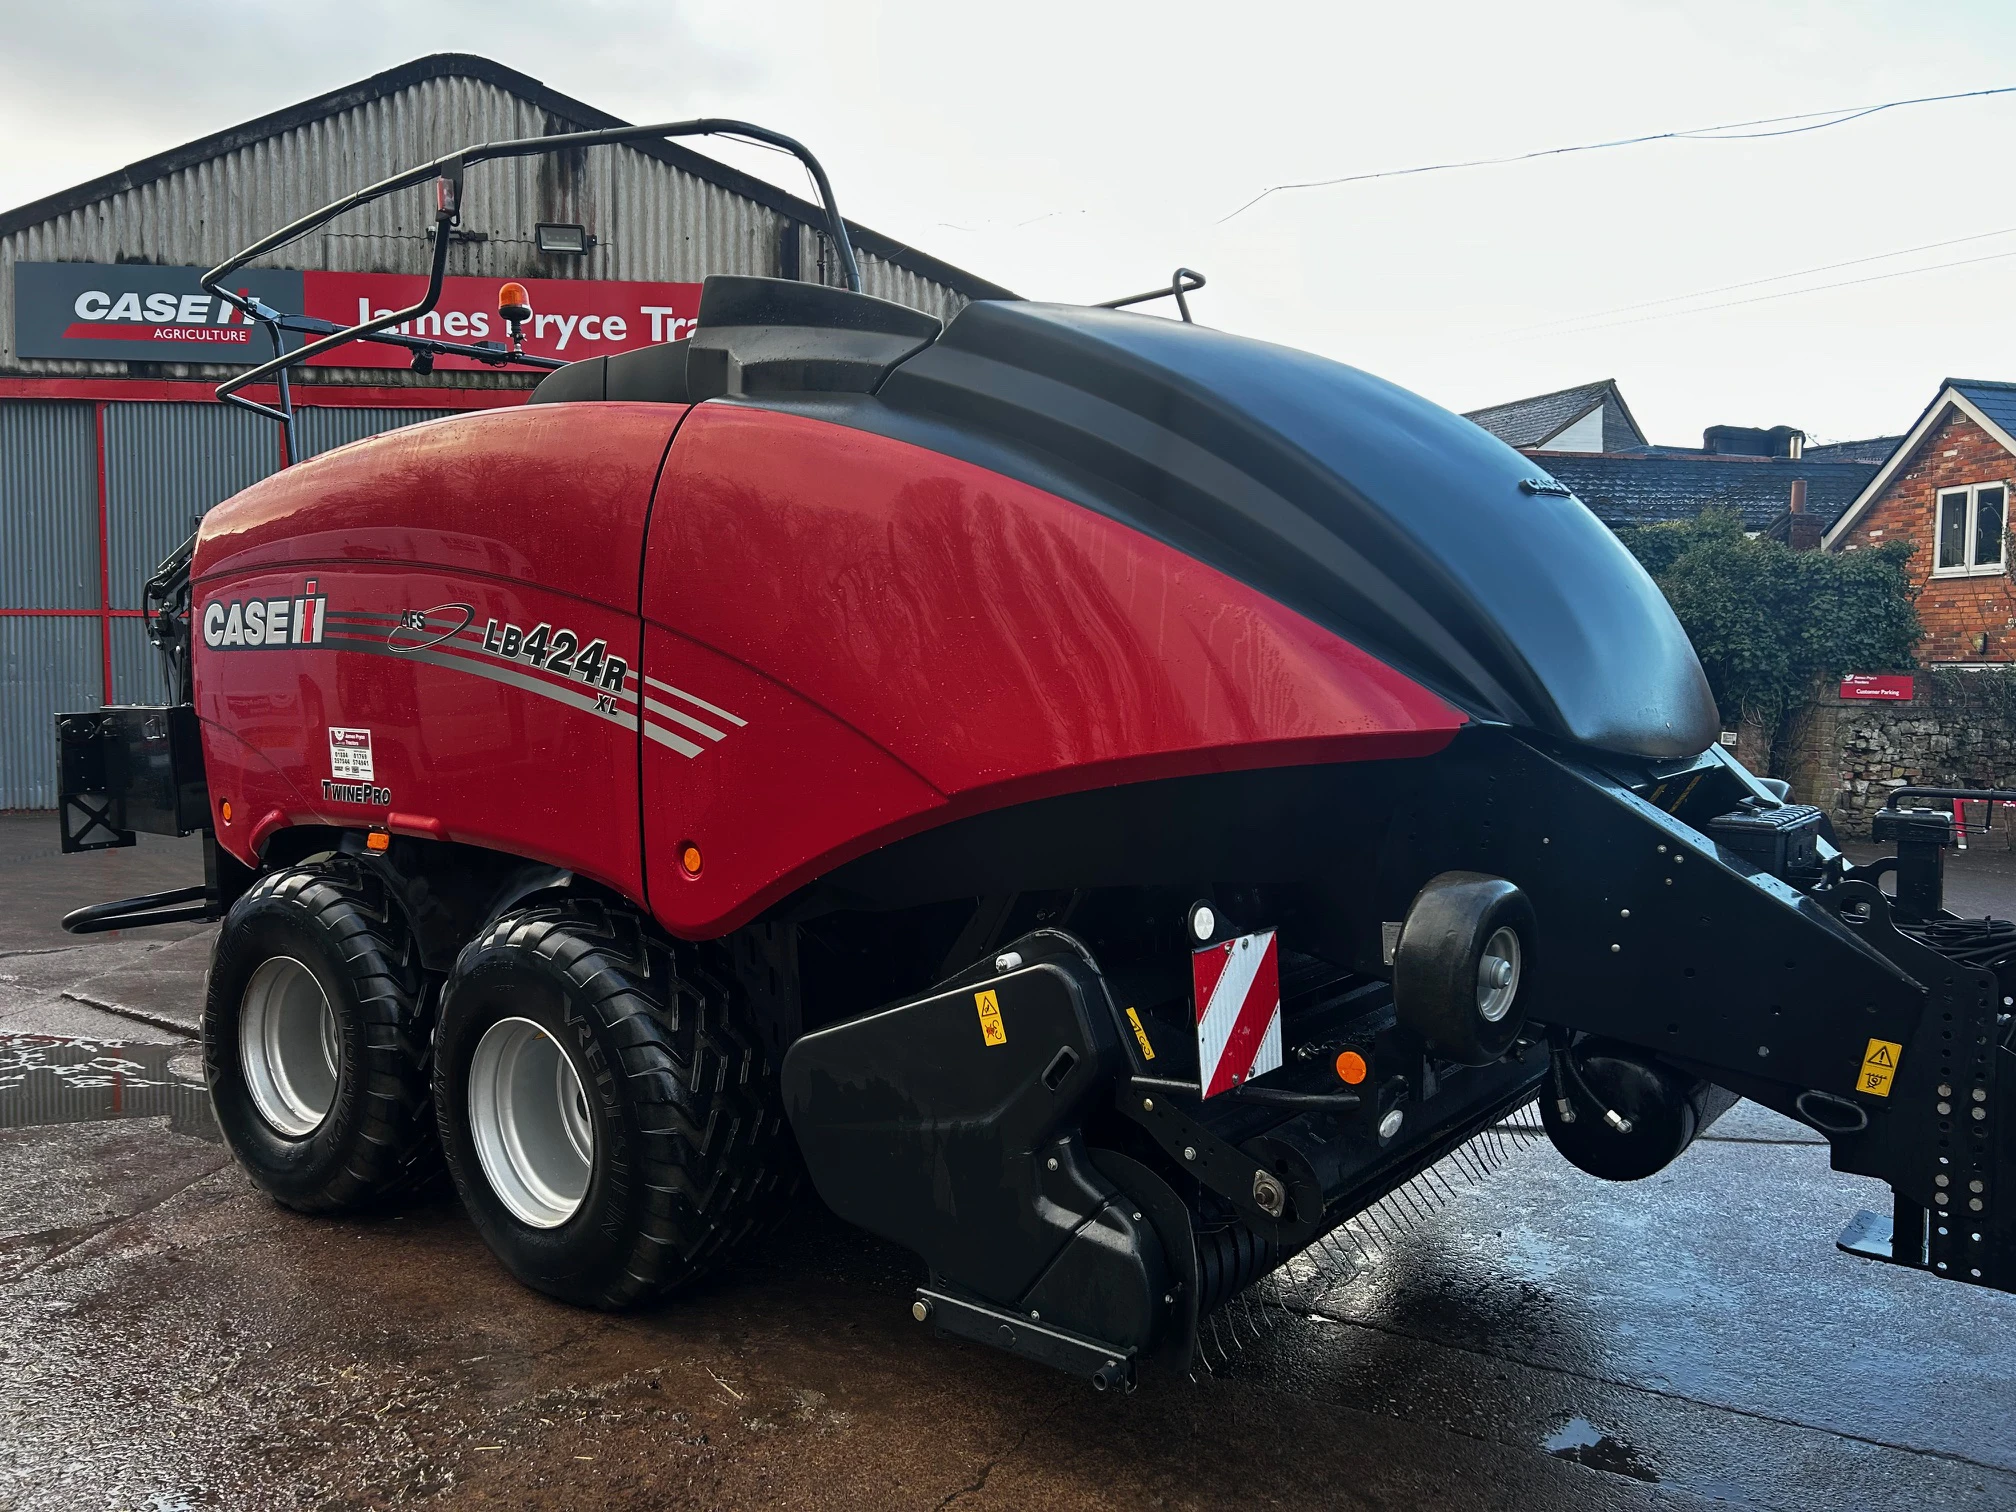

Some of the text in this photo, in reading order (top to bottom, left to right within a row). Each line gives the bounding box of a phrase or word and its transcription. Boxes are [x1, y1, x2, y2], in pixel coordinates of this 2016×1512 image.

[74, 290, 212, 324] CASE
[153, 328, 247, 342] AGRICULTURE
[203, 600, 290, 647] CASE
[401, 608, 426, 631] AFS
[482, 618, 628, 695] LB424R
[593, 693, 618, 716] XL
[1881, 689, 1900, 697] Parking
[562, 991, 631, 1244] VREDESTEIN
